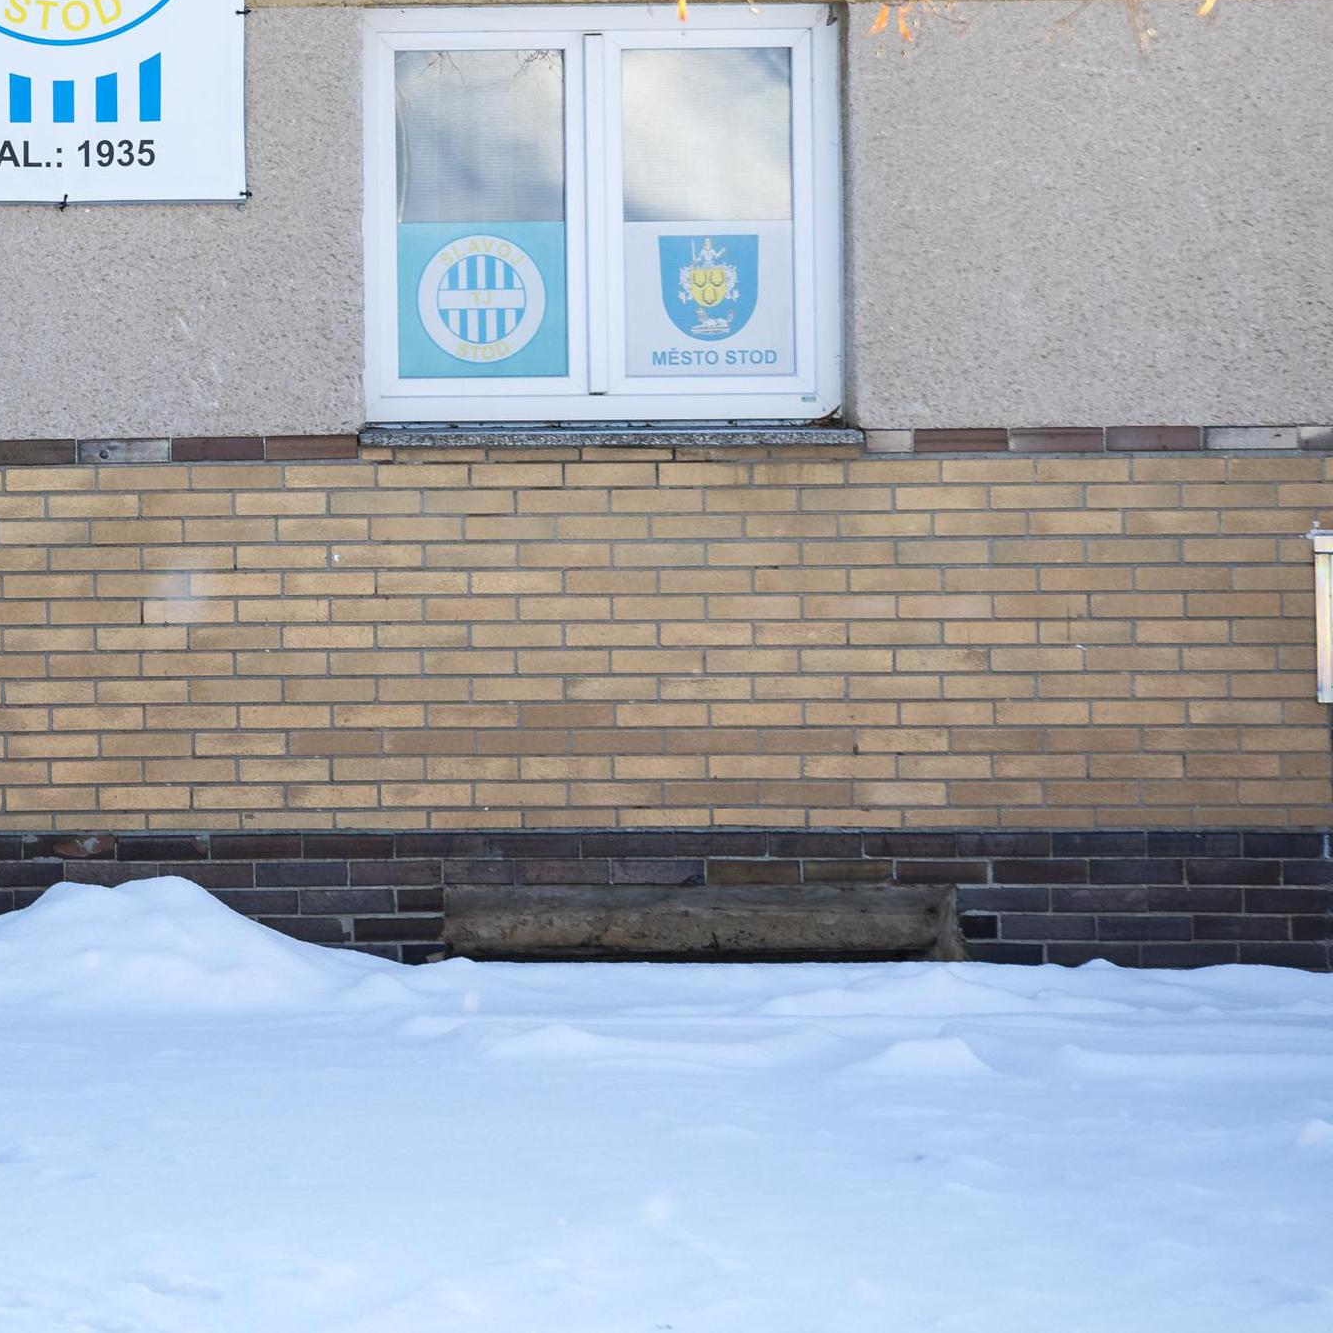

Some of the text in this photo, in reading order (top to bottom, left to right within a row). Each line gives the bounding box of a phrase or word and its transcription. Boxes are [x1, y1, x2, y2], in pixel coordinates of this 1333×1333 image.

[77, 139, 156, 168] 1935
[439, 236, 525, 266] SLAVOJ
[470, 291, 492, 307] TJ
[456, 341, 510, 360] STOD
[652, 345, 778, 367] MĚSTO STOD
